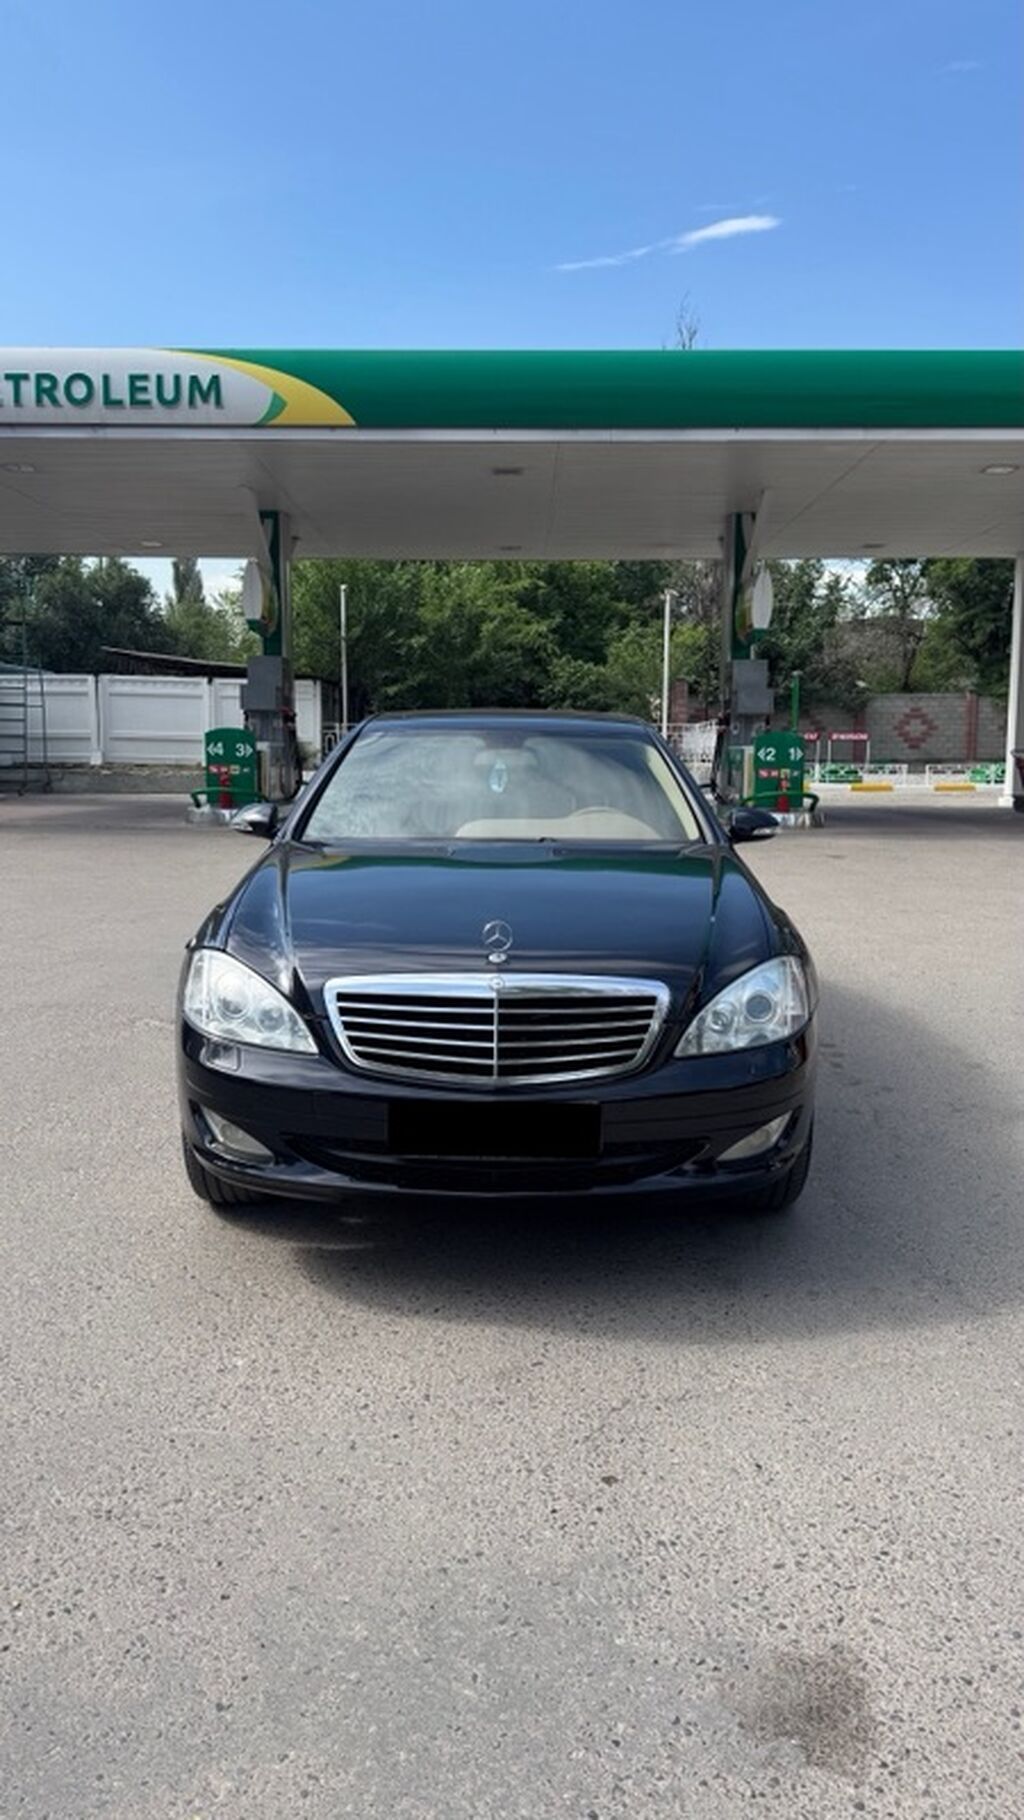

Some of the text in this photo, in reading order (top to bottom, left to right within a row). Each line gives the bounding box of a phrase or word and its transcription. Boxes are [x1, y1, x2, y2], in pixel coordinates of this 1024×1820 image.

[0, 373, 223, 408] TROLEUM
[213, 742, 244, 757] 4 3
[766, 748, 796, 761] 2 1
